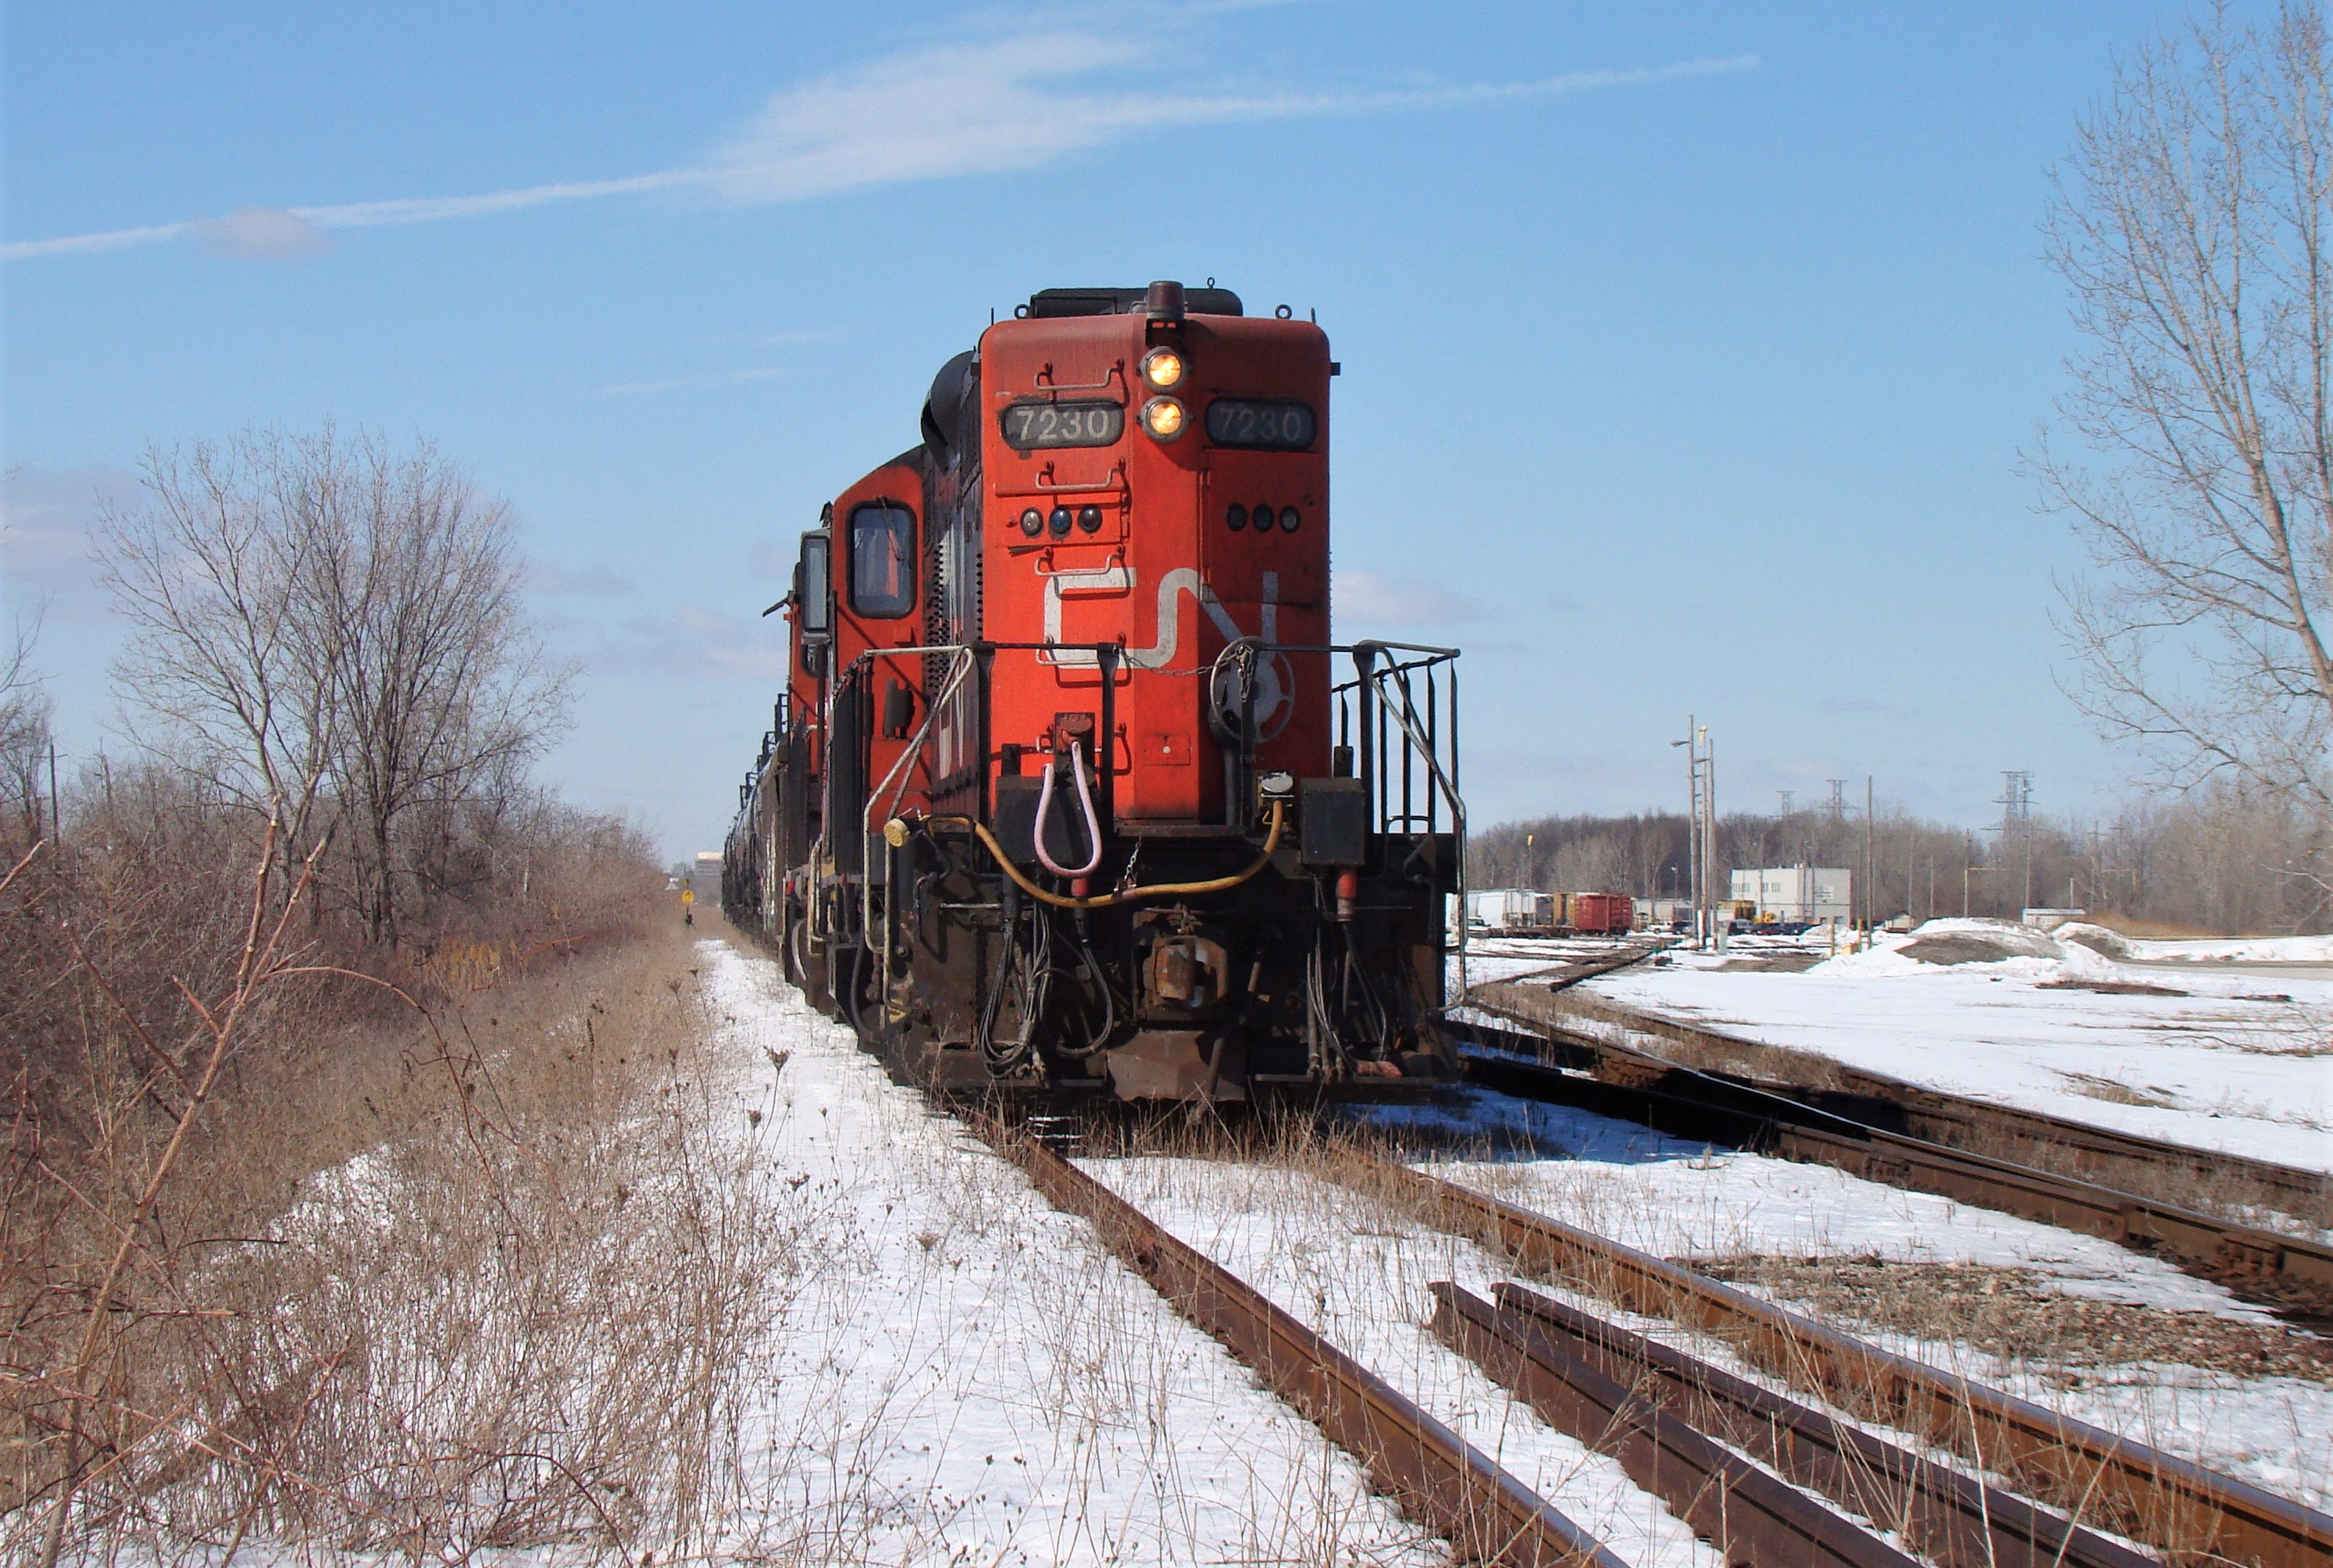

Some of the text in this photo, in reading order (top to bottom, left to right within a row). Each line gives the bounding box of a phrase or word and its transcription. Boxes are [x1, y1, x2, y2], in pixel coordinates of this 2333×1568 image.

[1016, 408, 1109, 441] 7230
[1218, 407, 1301, 441] 7230
[1043, 566, 1279, 670] CN
